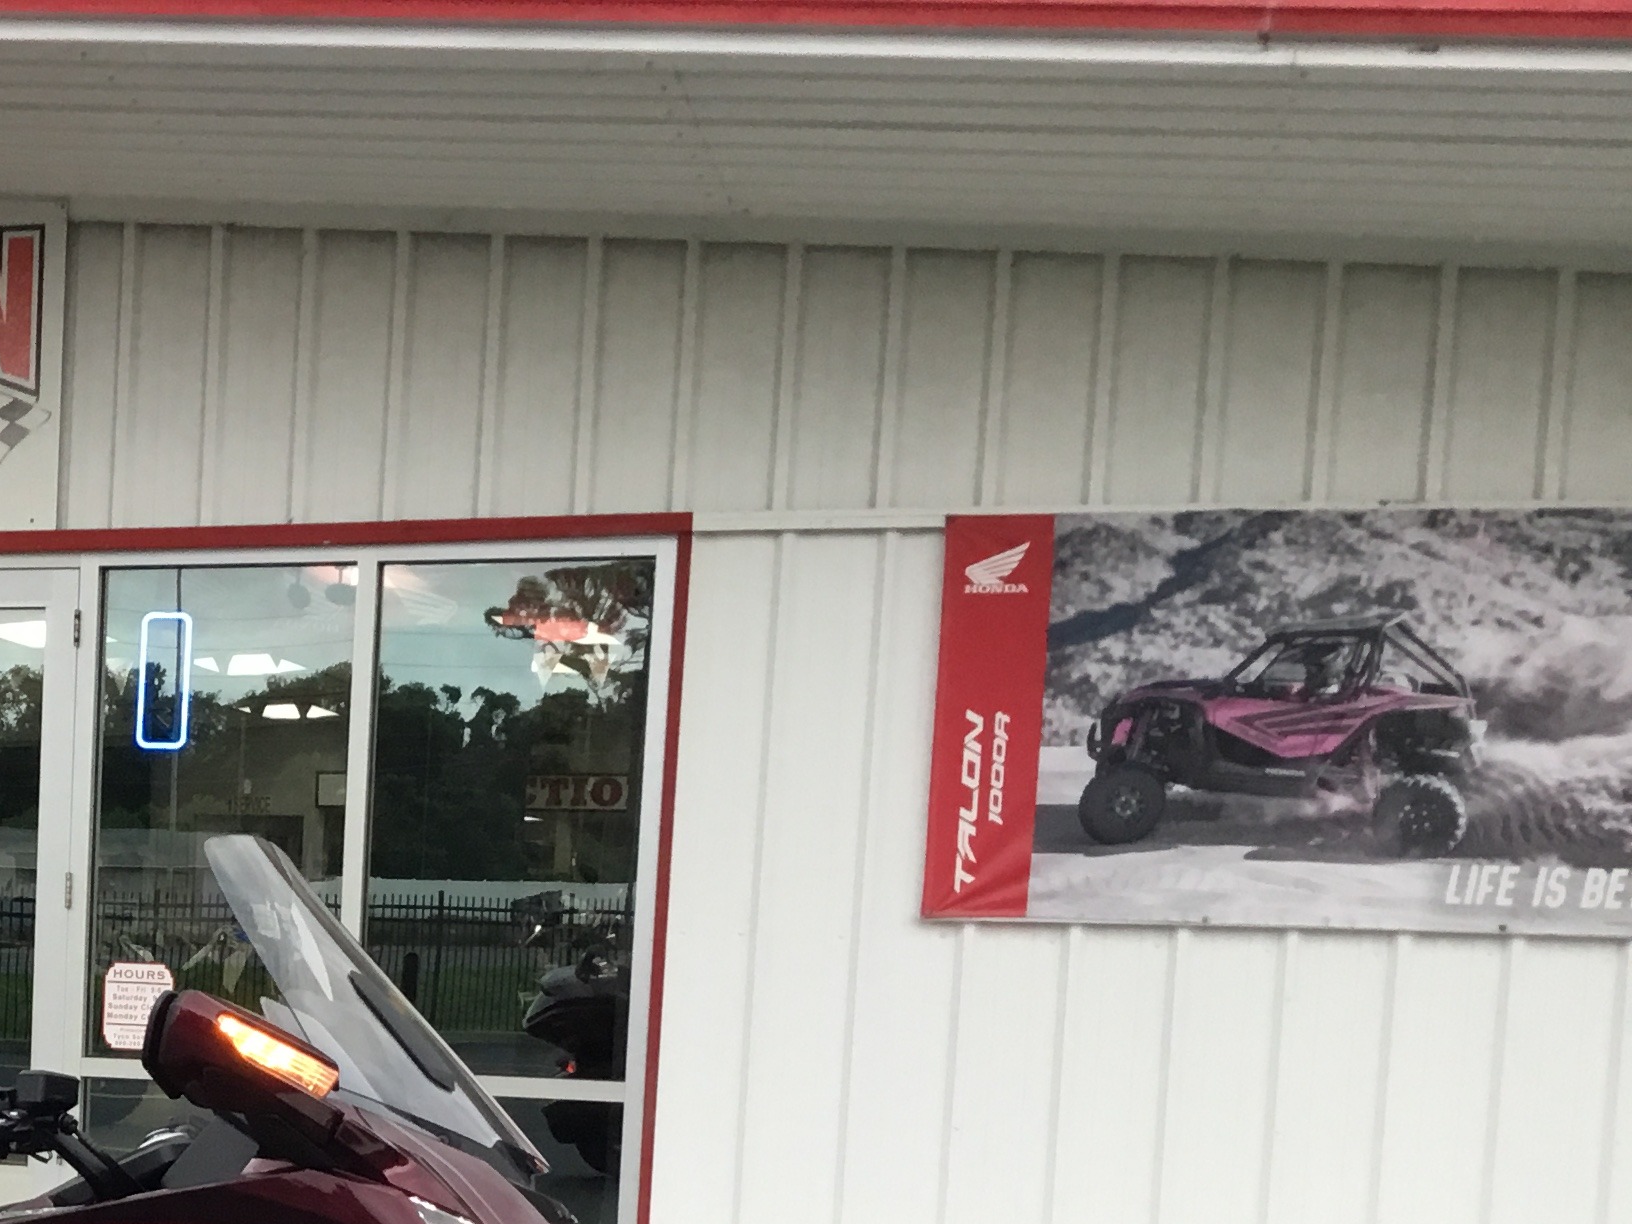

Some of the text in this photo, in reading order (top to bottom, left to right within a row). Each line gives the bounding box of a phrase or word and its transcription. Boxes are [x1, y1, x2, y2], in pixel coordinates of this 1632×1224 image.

[964, 583, 1030, 594] HONDA
[988, 711, 1011, 825] 1000R
[953, 709, 984, 893] TALON
[1445, 864, 1632, 909] LIFE IS BE
[113, 969, 166, 980] HOURS
[112, 993, 148, 1002] Saturday
[108, 1002, 138, 1010] Sunday
[107, 1012, 138, 1020] Monday
